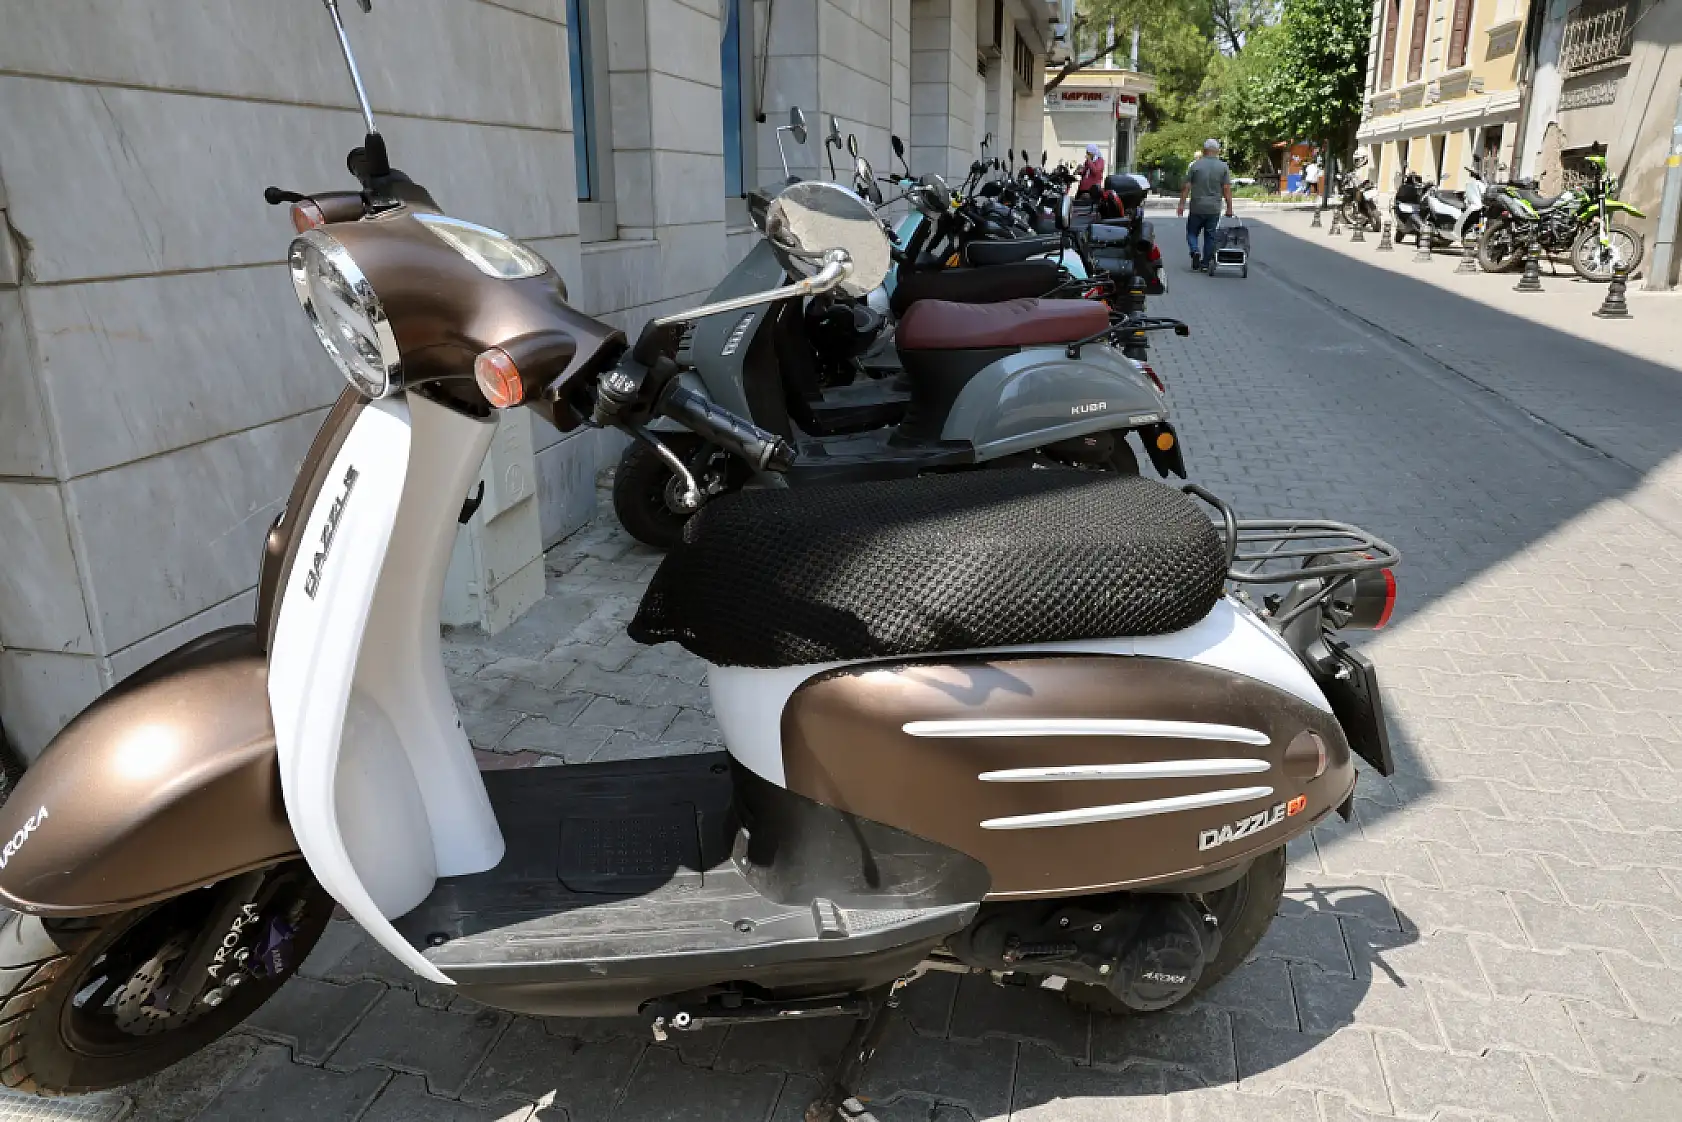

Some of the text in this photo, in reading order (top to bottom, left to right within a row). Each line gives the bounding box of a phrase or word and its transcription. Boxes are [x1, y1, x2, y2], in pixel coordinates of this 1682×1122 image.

[1071, 401, 1107, 415] KUBA
[304, 464, 360, 601] DAZZLE
[1198, 802, 1286, 851] DAZZLE
[207, 902, 259, 978] ARORA
